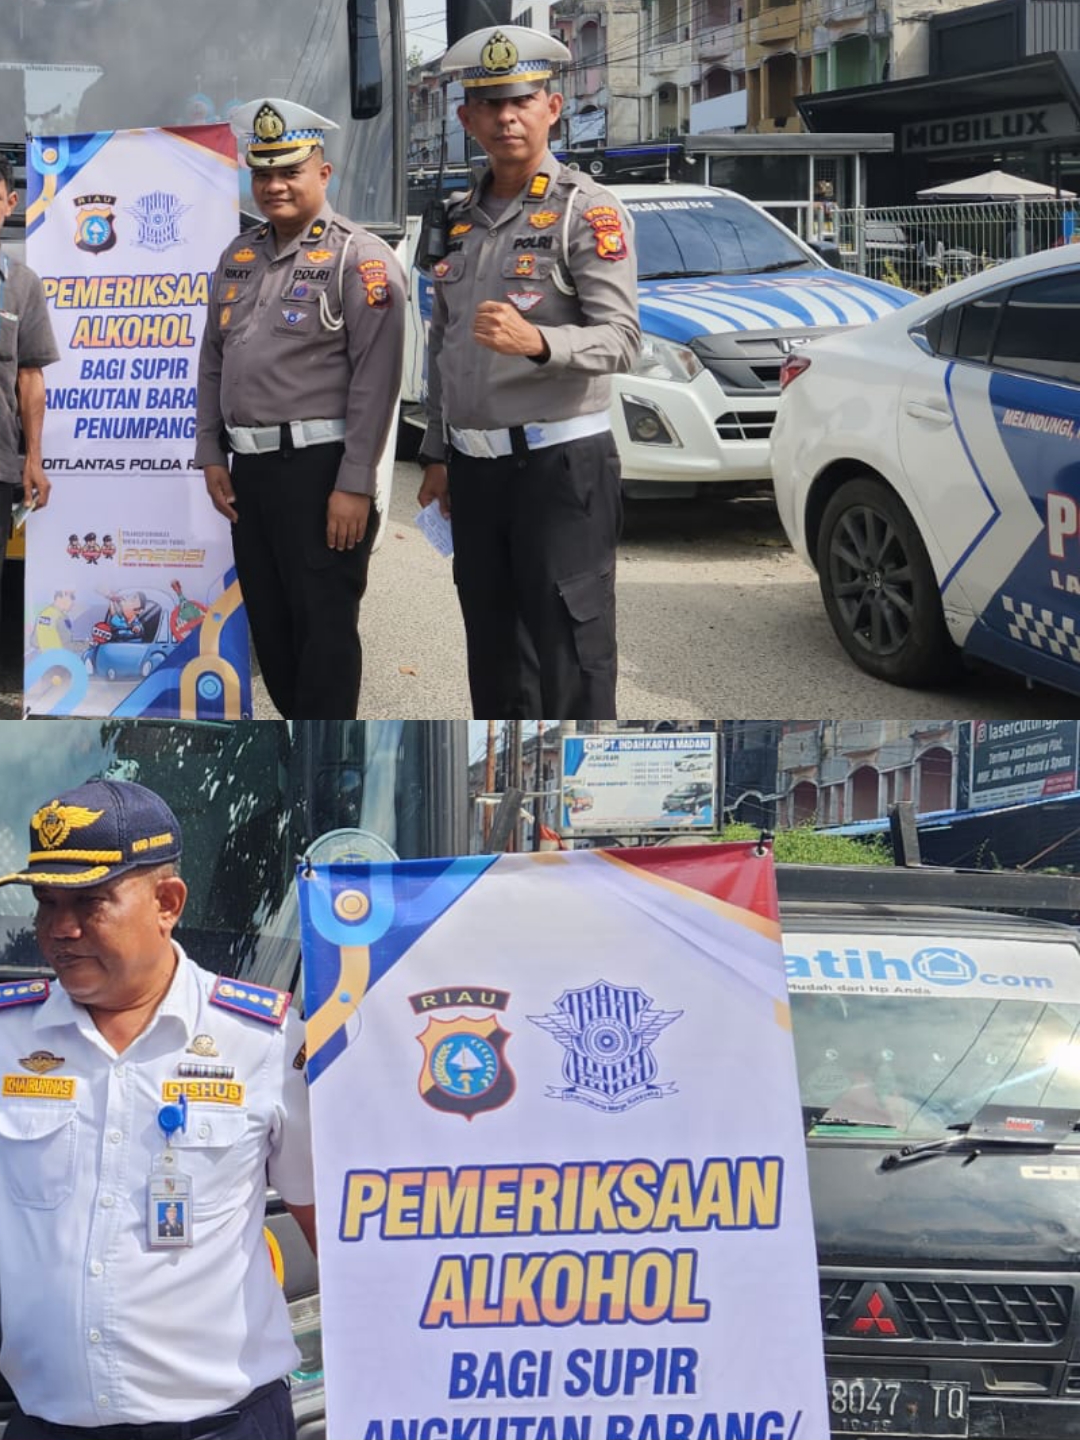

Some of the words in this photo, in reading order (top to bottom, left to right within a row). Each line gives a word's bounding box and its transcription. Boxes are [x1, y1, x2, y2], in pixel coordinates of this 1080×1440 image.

[906, 110, 1048, 149] MOBILUX
[77, 195, 113, 206] RIAU
[513, 236, 553, 250] POLRI
[224, 268, 252, 280] RIKKY
[293, 271, 329, 282] POLRI
[41, 272, 215, 309] PEMERIKSAA
[69, 313, 196, 349] ALKOHOL
[79, 358, 125, 380] BAGI
[130, 357, 189, 380] SUPIR
[45, 387, 141, 409] ANGKUTAN
[145, 387, 198, 409] BARA
[73, 416, 197, 439] PENUMPANG
[1002, 408, 1075, 440] MELINDUNGI,
[129, 459, 182, 471] POLDA
[122, 548, 206, 562] PRESISI
[677, 738, 710, 750] MADANI
[783, 949, 912, 982] atih
[421, 990, 497, 1008] RIAU
[787, 983, 833, 993] Mudah
[836, 984, 865, 993] dari
[869, 985, 890, 994] Hp
[894, 986, 932, 994] Anda
[167, 1081, 240, 1100] DISHUB
[339, 1156, 784, 1242] PEMERIKSAAN
[419, 1247, 711, 1329] ALKOHOL
[448, 1350, 552, 1399] BAGI
[564, 1348, 699, 1397] SUPIR
[931, 1383, 964, 1419] TQ
[363, 1415, 592, 1440] ANGKUTAN
